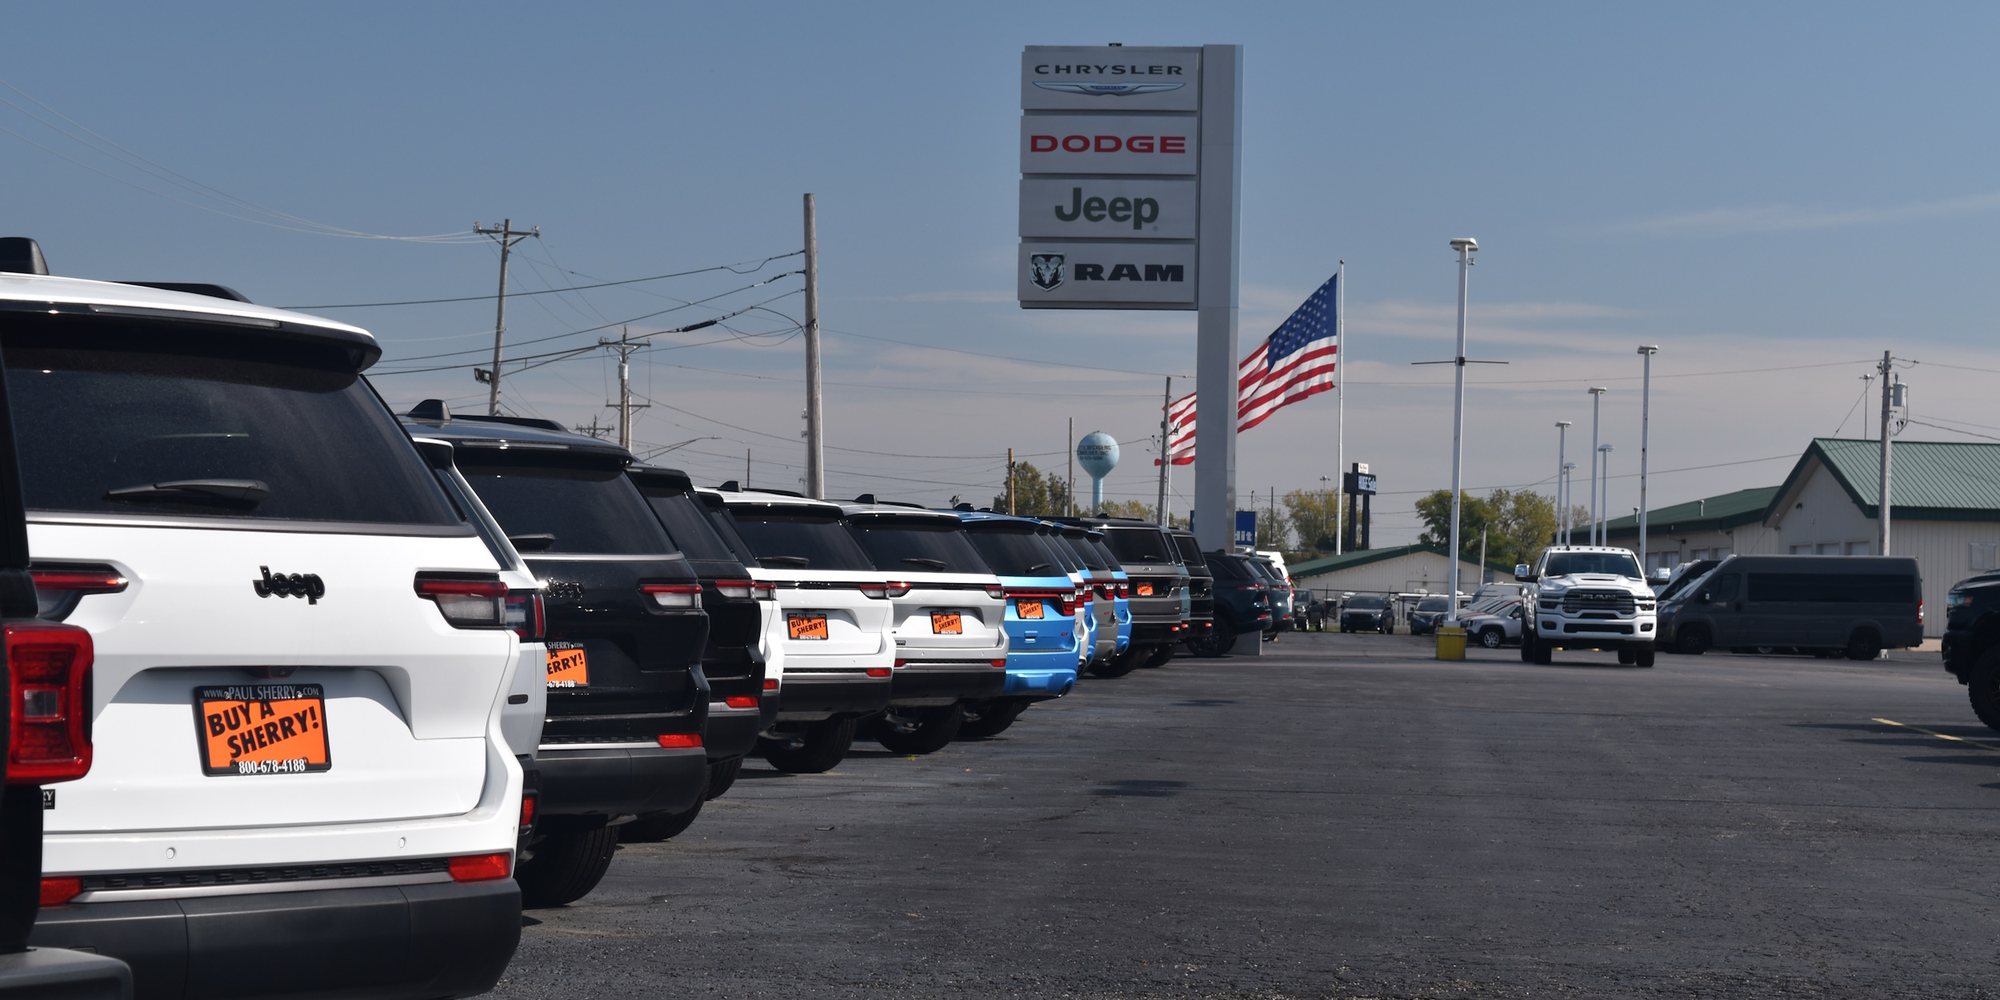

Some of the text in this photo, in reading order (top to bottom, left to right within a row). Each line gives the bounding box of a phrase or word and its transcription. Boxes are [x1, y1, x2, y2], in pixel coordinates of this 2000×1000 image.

[1034, 64, 1183, 75] CHRYSLER
[1030, 134, 1186, 154] DODGE
[1054, 187, 1160, 230] Jeep
[1074, 263, 1184, 282] RAM
[1235, 530, 1252, 541] dit
[252, 565, 325, 605] Jeep
[791, 618, 805, 628] BUY
[796, 620, 825, 635] SHERRY!
[548, 641, 571, 650] SHERRY
[550, 649, 559, 659] A
[547, 652, 584, 675] ERRY!
[547, 680, 575, 688] -678-4188
[228, 686, 256, 700] PAUL
[257, 685, 296, 700] SHERRY
[207, 700, 276, 738] BUY A
[227, 706, 319, 759] SHERRY!
[238, 759, 306, 774] 800-678-4188
